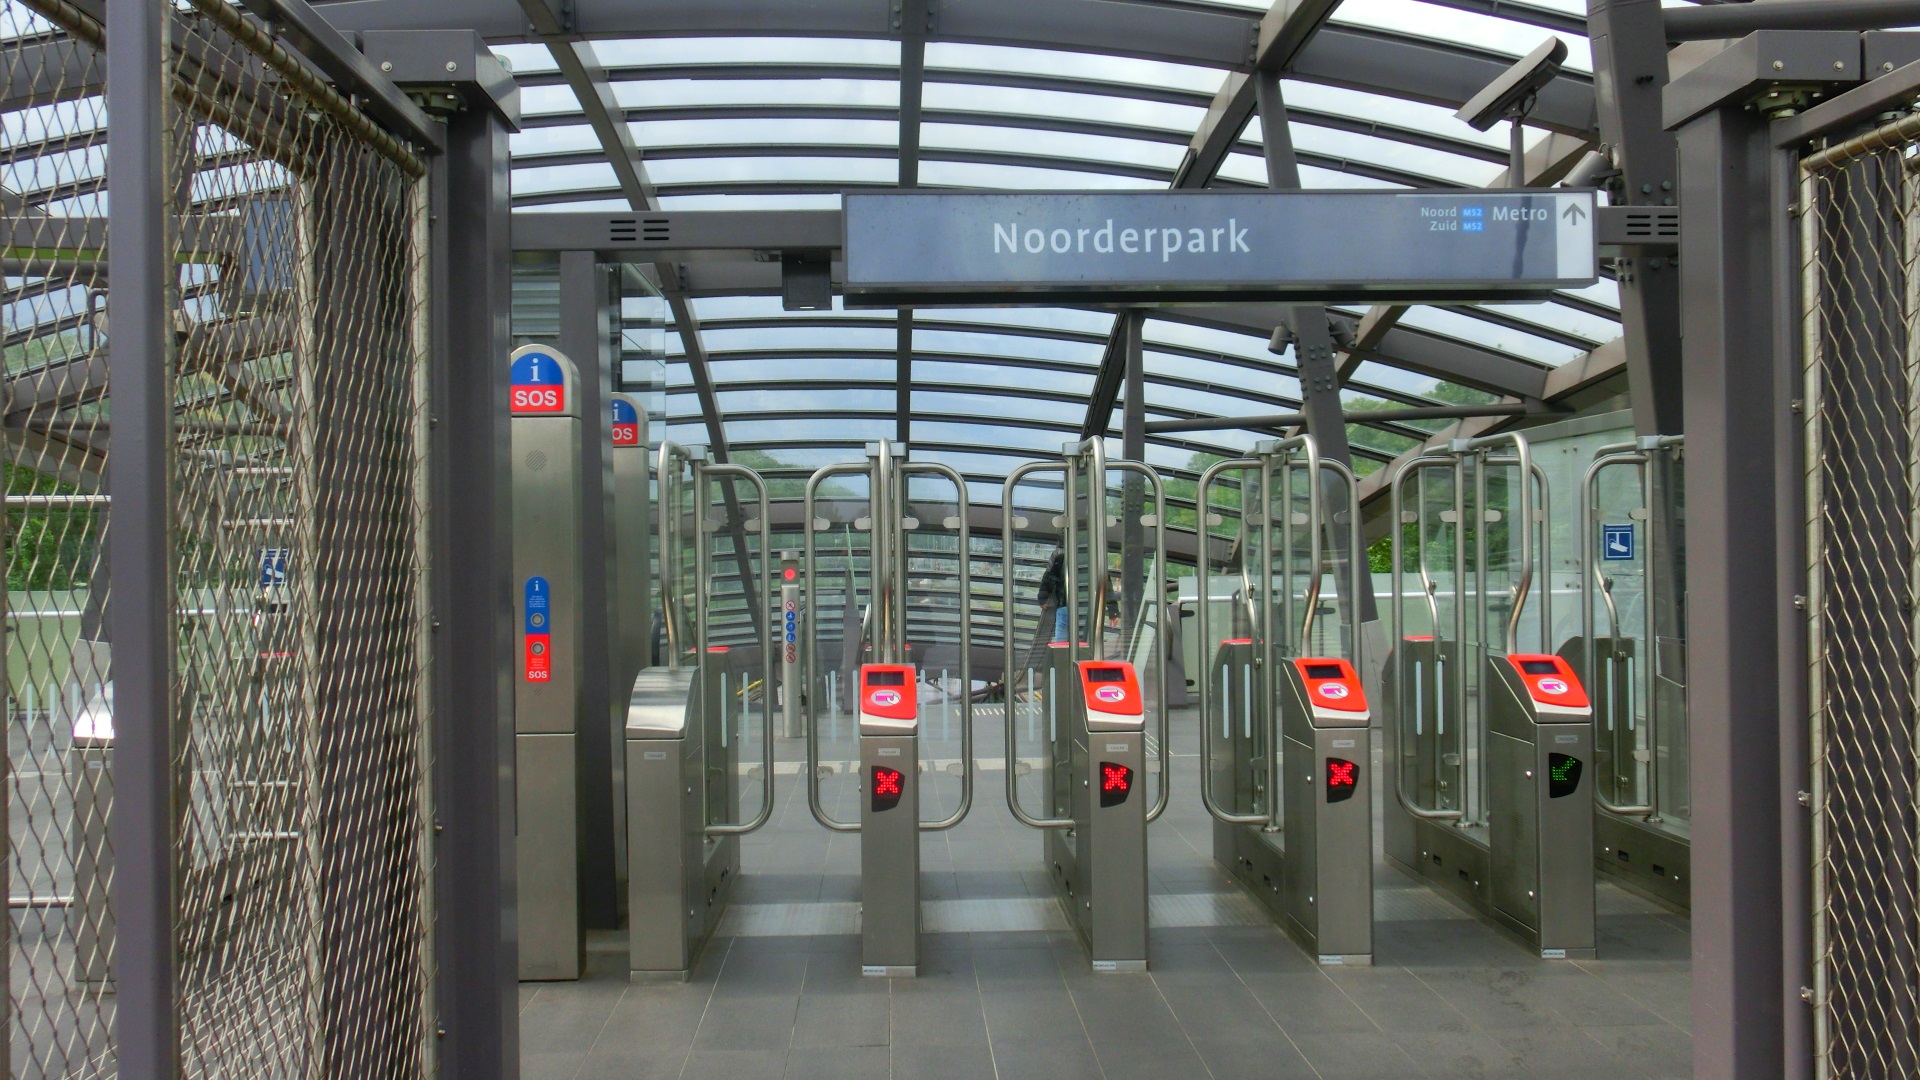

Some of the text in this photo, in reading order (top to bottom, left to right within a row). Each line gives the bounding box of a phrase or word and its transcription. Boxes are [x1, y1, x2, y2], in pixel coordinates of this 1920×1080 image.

[1421, 206, 1482, 217] Noord M52
[1492, 206, 1548, 221] Metro
[1430, 220, 1482, 231] Zuid M52
[993, 218, 1250, 262] Noorderpark
[514, 390, 557, 406] SOS
[612, 427, 633, 441] OS
[528, 671, 547, 679] SOS
